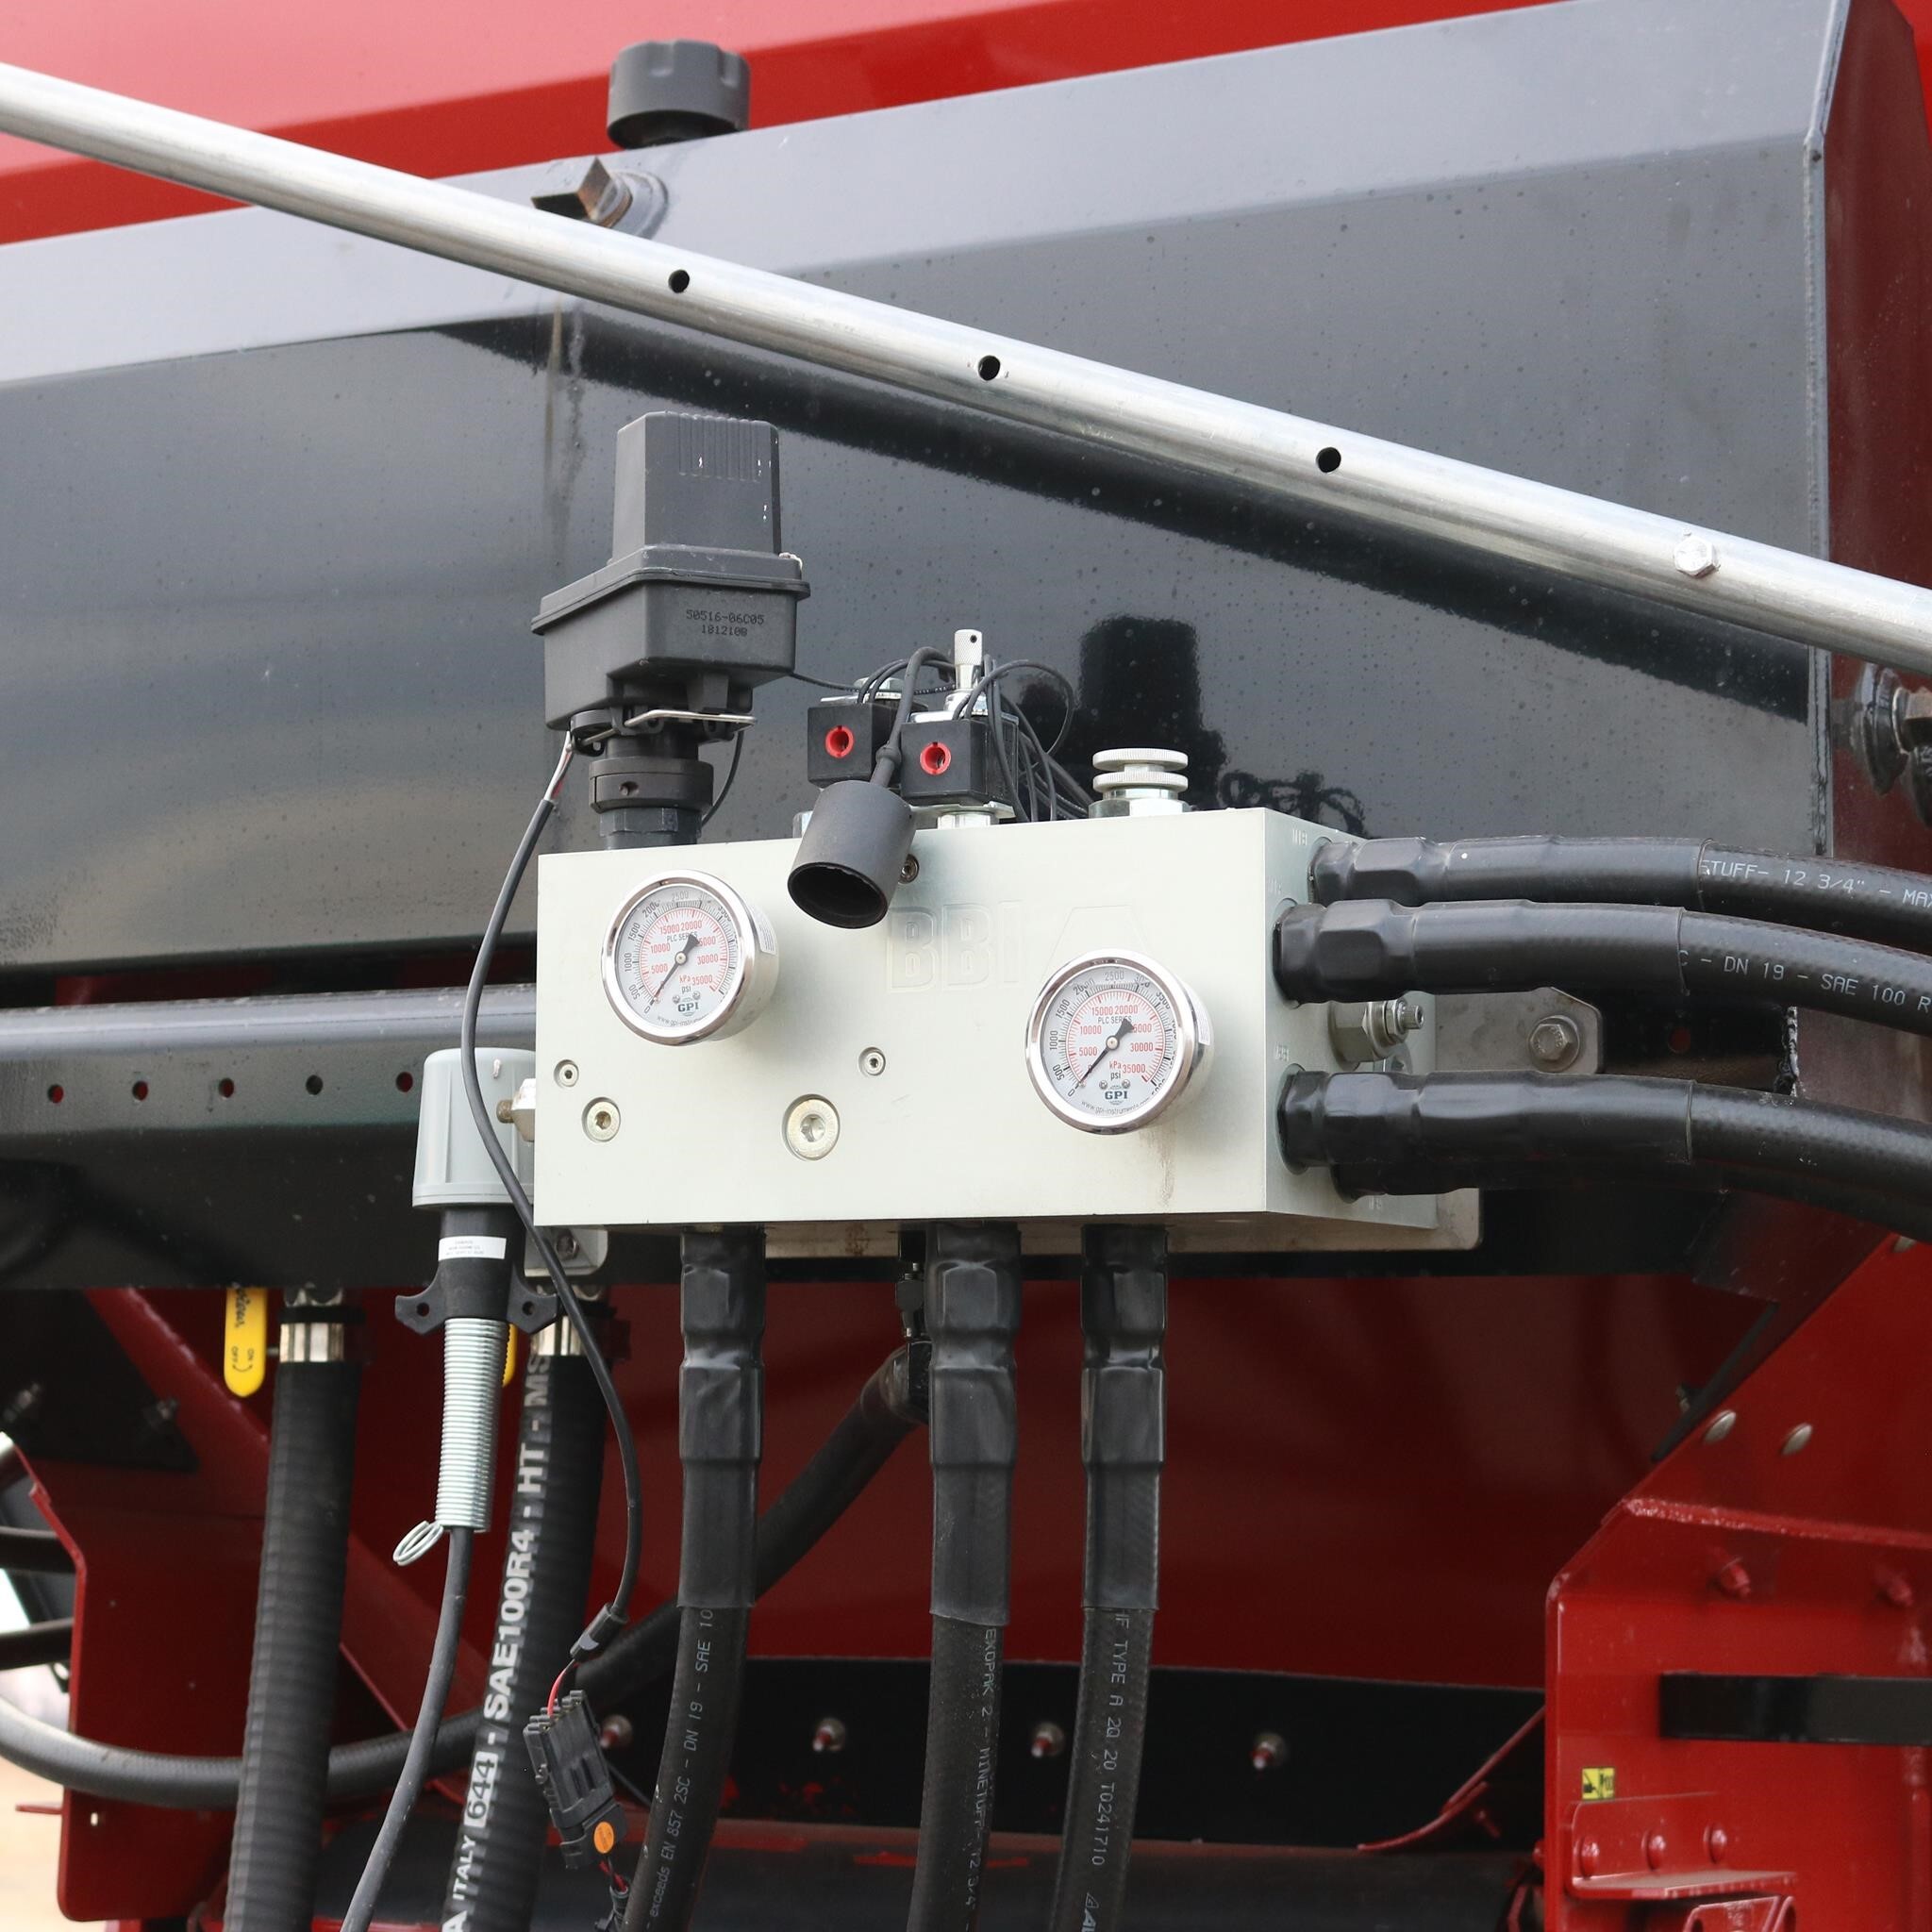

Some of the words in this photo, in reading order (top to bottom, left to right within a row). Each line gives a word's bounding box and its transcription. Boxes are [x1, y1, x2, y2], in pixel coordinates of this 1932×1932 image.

[686, 609, 765, 625] 50516-06C05
[1783, 869, 1807, 886] 12
[659, 924, 679, 934] 15000
[680, 921, 702, 931] 20000
[628, 923, 641, 941] 1500
[667, 933, 677, 942] PLC
[698, 936, 716, 946] 5000
[651, 943, 670, 954] 10000
[697, 954, 719, 965] 30000
[651, 963, 668, 974] 5000
[692, 974, 713, 986] 35000
[1105, 970, 1124, 981] 2500
[1724, 956, 1749, 974] DN
[1763, 961, 1785, 980] 19
[1821, 974, 1858, 995] SAE
[1872, 984, 1906, 1006] 100
[628, 984, 641, 1000] 500
[678, 1002, 699, 1012] GPI
[1056, 999, 1071, 1019] 1500
[1091, 1007, 1113, 1016] 15000
[1114, 1005, 1139, 1014] 20000
[1080, 1025, 1102, 1035] 10000
[1132, 1024, 1152, 1033] 5000
[1049, 1030, 1058, 1050] 1000
[1078, 1047, 1097, 1056] 5000
[1130, 1042, 1153, 1052] 30000
[1109, 1060, 1122, 1069] kPa
[1123, 1064, 1145, 1074] 35000
[1052, 1064, 1064, 1081] 500
[1110, 1071, 1121, 1080] psi
[1068, 1088, 1075, 1097] 0
[1105, 1091, 1128, 1099] GPI
[695, 1639, 711, 1673] SAE
[1111, 1641, 1128, 1684] TYPE
[452, 1835, 476, 1901] ITALY
[466, 1759, 495, 1821] 644
[482, 1528, 536, 1723] SAE100R4
[517, 1441, 545, 1492] HT
[1108, 1694, 1124, 1706] A
[689, 1701, 703, 1720] 19
[981, 1707, 992, 1717] 2
[683, 1729, 699, 1752] DN
[1103, 1748, 1118, 1771] 20
[674, 1775, 691, 1805] 2SC
[667, 1809, 683, 1837] 857
[660, 1840, 676, 1859] EN
[649, 1866, 671, 1917] exceeds
